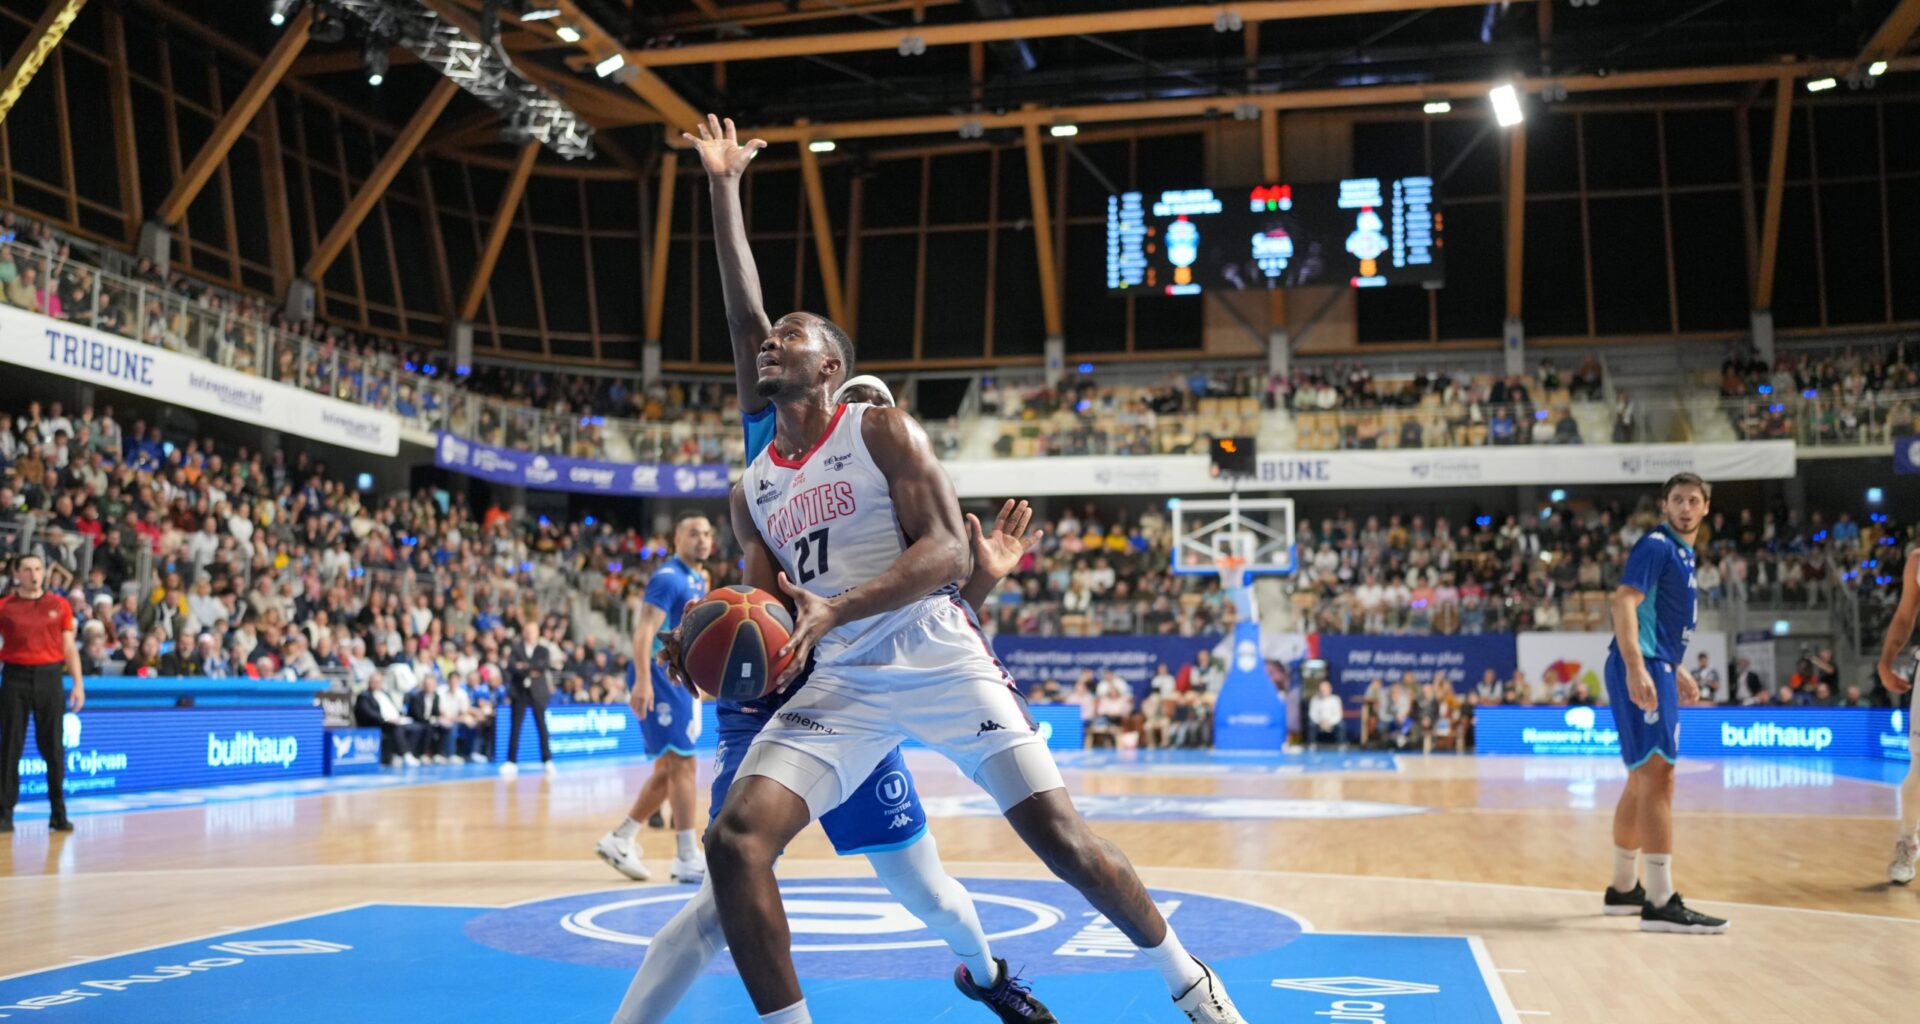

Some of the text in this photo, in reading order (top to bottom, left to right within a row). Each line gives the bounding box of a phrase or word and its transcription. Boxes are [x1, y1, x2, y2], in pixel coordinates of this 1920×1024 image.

[45, 329, 154, 387] TRIBUNE
[767, 480, 857, 549] NANTES
[794, 527, 830, 585] 27
[208, 730, 298, 770] bulthaup
[1721, 720, 1833, 752] bulthaup
[884, 779, 902, 800] U
[80, 957, 244, 991] Auto
